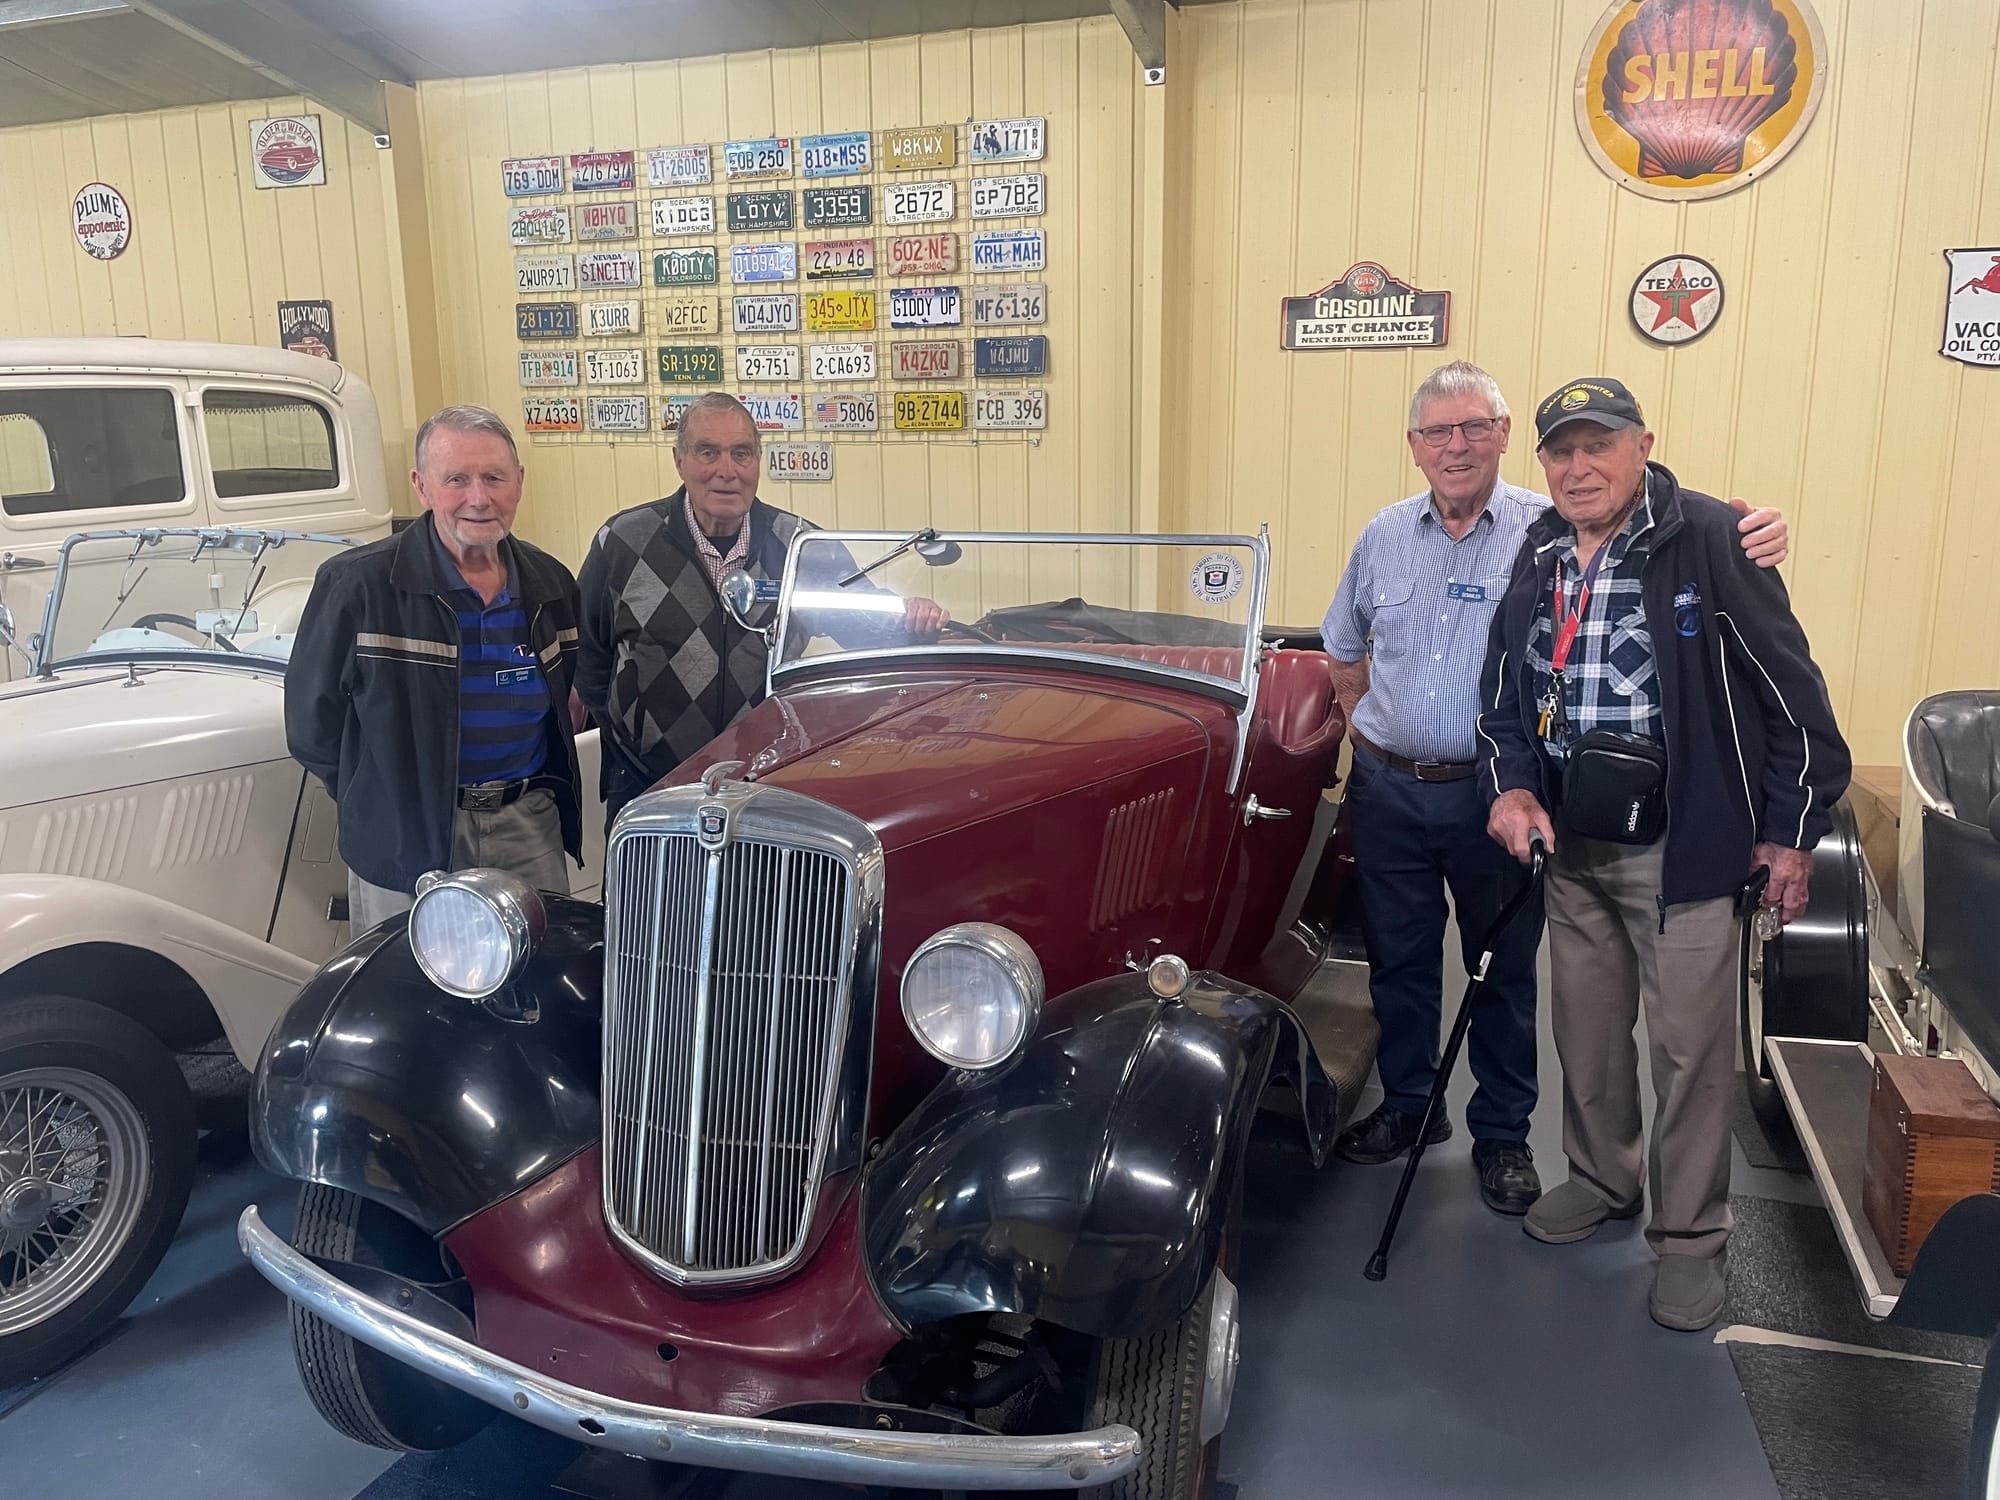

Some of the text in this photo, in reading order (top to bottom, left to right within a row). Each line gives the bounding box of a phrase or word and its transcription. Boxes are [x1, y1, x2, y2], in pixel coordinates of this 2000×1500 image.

[1622, 47, 1774, 104] SHELL
[259, 122, 281, 148] OLDER
[288, 122, 312, 144] WISER
[1000, 120, 1040, 131] Wyoming
[820, 137, 852, 148] Minnesota
[892, 136, 943, 157] W8KWX
[1005, 129, 1028, 152] 171
[591, 152, 613, 163] IDAHO
[664, 149, 699, 159] MONTANA
[758, 149, 784, 169] 250
[805, 144, 867, 170] 818 MSS
[582, 164, 603, 183] 276
[607, 160, 626, 181] 797
[993, 177, 1020, 185] SCENIC
[746, 193, 772, 203] SCENIC
[820, 189, 854, 197] TRACTOR
[888, 183, 950, 195] NEW HAMPSHIRE
[76, 193, 122, 223] PLUME
[670, 198, 694, 207] SCENIC
[813, 195, 862, 219] 3359
[895, 190, 943, 215] 2672
[975, 204, 1039, 216] NEW HAMPSHIRE
[731, 220, 789, 231] NEW HAMPSHIRE
[808, 214, 868, 226] NEW HAMPSHIRE
[902, 213, 936, 222] TRACTOR
[78, 218, 126, 238] appotenic
[656, 224, 711, 235] NEW HAMPSHIRE
[593, 253, 623, 262] NEVADA
[814, 252, 831, 270] 22
[848, 249, 865, 267] 48
[975, 242, 1041, 264] KRH MAH
[528, 259, 559, 267] CALIFORNIA
[581, 261, 635, 283] SINCITY
[519, 268, 569, 288] 2WUR917
[668, 273, 702, 281] COLORADO
[1646, 276, 1713, 290] TEXACO
[666, 305, 708, 326] W2FCC
[810, 296, 870, 319] 345 JTX
[893, 296, 957, 318] GIDDY UP
[1314, 293, 1416, 319] GASOLINE
[281, 306, 330, 335] HOLLYWOOD
[590, 307, 630, 329] K3URR
[1302, 320, 1430, 336] LAST CHANCE
[1955, 321, 2000, 339] VAC
[831, 344, 852, 352] TENN
[894, 342, 957, 352] NORTH CAROLINA
[990, 339, 1029, 347] FLORIDA
[1301, 336, 1330, 345] NEXT
[1331, 335, 1375, 343] SERVICE
[1397, 333, 1430, 342] MILES
[1948, 339, 1976, 352] OIL
[531, 352, 563, 360] OKLAHOMA
[899, 350, 950, 372] K4ZKQ
[990, 346, 1030, 366] W4JMU
[1977, 352, 1997, 361] PTY.
[521, 360, 574, 379] TFB 914
[536, 398, 565, 406] Georgia
[775, 401, 799, 420] 462
[977, 398, 1042, 421] FCB 396
[526, 407, 578, 425] XZ 4339
[597, 404, 638, 424] WB9PZC
[840, 402, 875, 422] 5806
[770, 450, 829, 471] AEG 868
[1628, 810, 1638, 832] adidas
